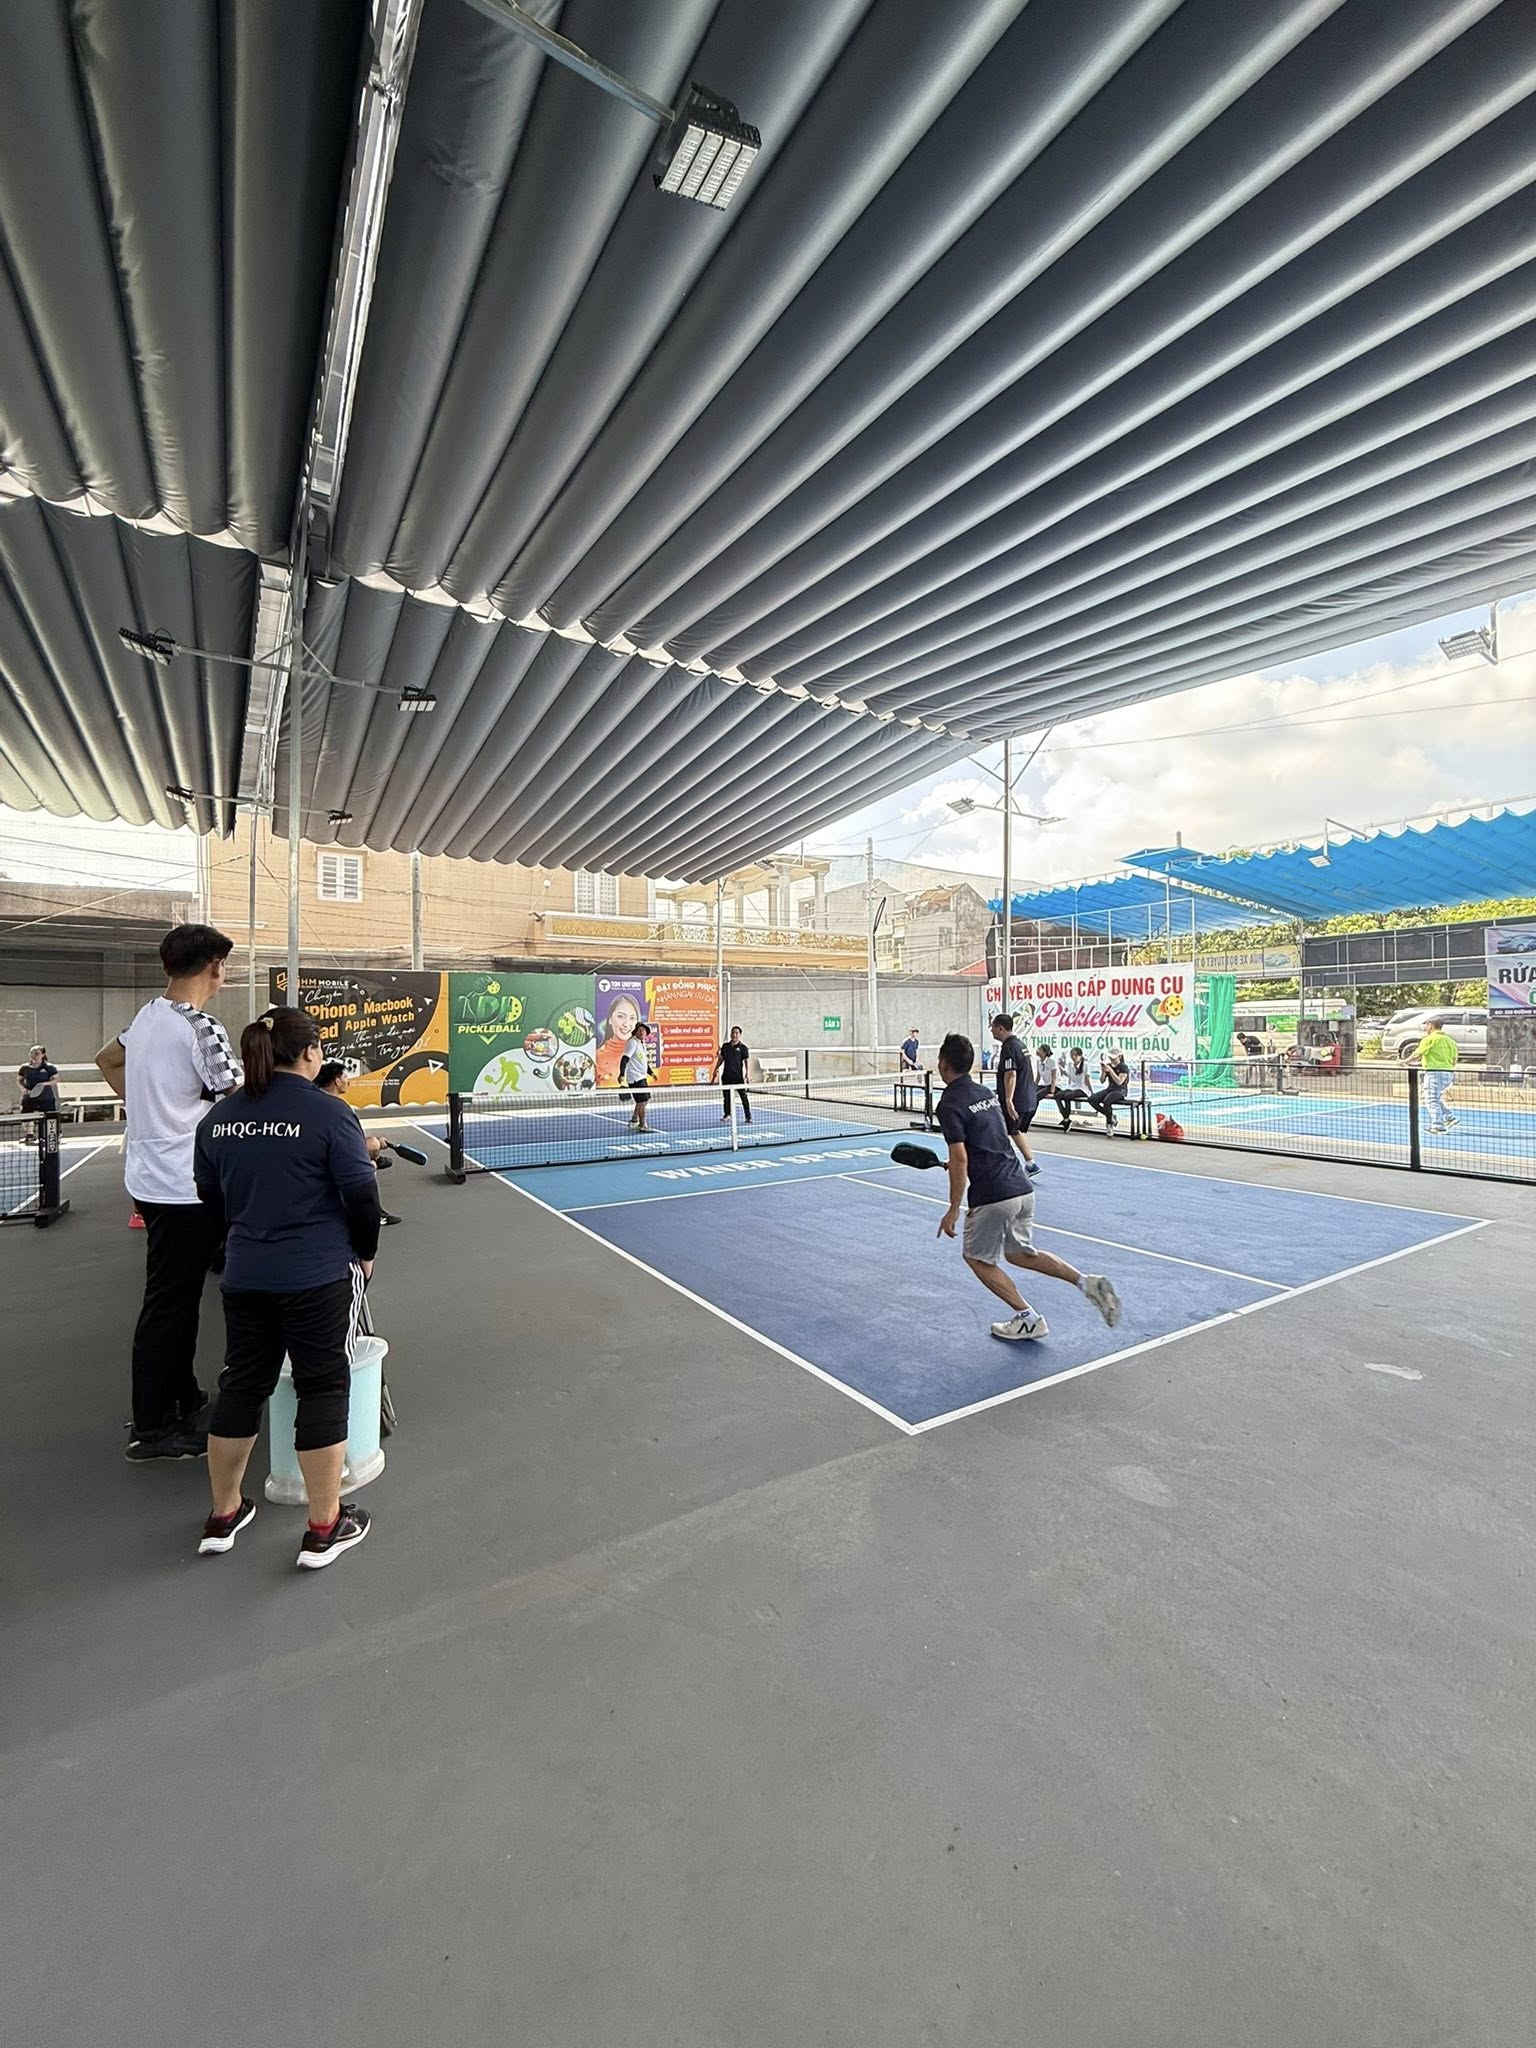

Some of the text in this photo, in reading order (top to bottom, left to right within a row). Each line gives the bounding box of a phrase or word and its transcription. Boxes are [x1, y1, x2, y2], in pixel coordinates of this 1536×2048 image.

[672, 979, 695, 989] ĐỒNG
[697, 982, 717, 992] PHỤC
[986, 982, 1032, 1002] CHYÊN
[1037, 981, 1073, 999] CUNG
[1077, 974, 1106, 997] CẤP
[1111, 977, 1155, 999] DỤNG
[364, 996, 413, 1014] Macbook
[1035, 1000, 1143, 1028] Pickleball
[345, 1017, 376, 1032] Apple
[381, 1011, 415, 1025] Watch
[458, 1025, 522, 1034] PICKLEBALL
[1118, 1037, 1137, 1050] THI
[1142, 1032, 1170, 1051] ĐẤU
[646, 1147, 892, 1179] WINER SPORT
